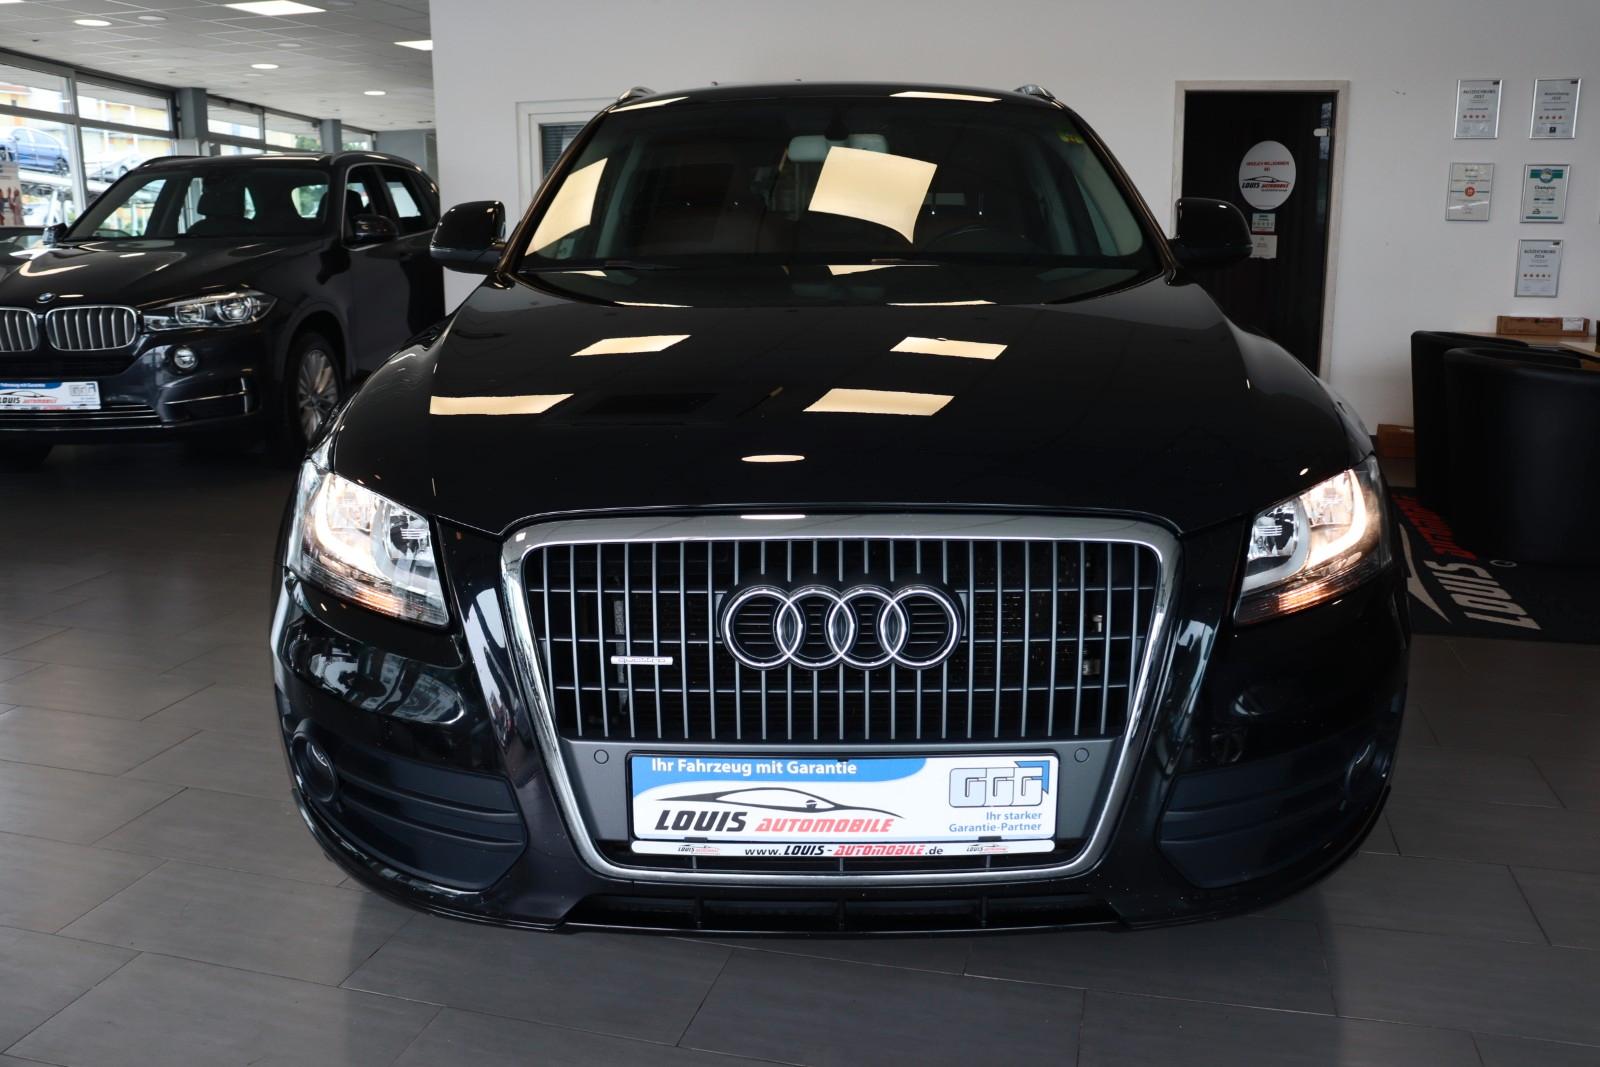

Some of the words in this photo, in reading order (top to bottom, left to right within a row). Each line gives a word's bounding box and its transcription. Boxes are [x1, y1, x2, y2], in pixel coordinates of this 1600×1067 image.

[1424, 560, 1541, 630] LOUIS
[652, 758, 674, 772] Ihr
[678, 758, 752, 776] Fahrzeug
[756, 761, 783, 774] mit
[787, 761, 857, 775] Garantie
[655, 810, 748, 832] LOUIS
[755, 818, 894, 833] AUTOMOBILE
[986, 812, 1001, 821] Ihr
[1004, 811, 1042, 820] starker
[949, 823, 1042, 832] Garantie-Partner
